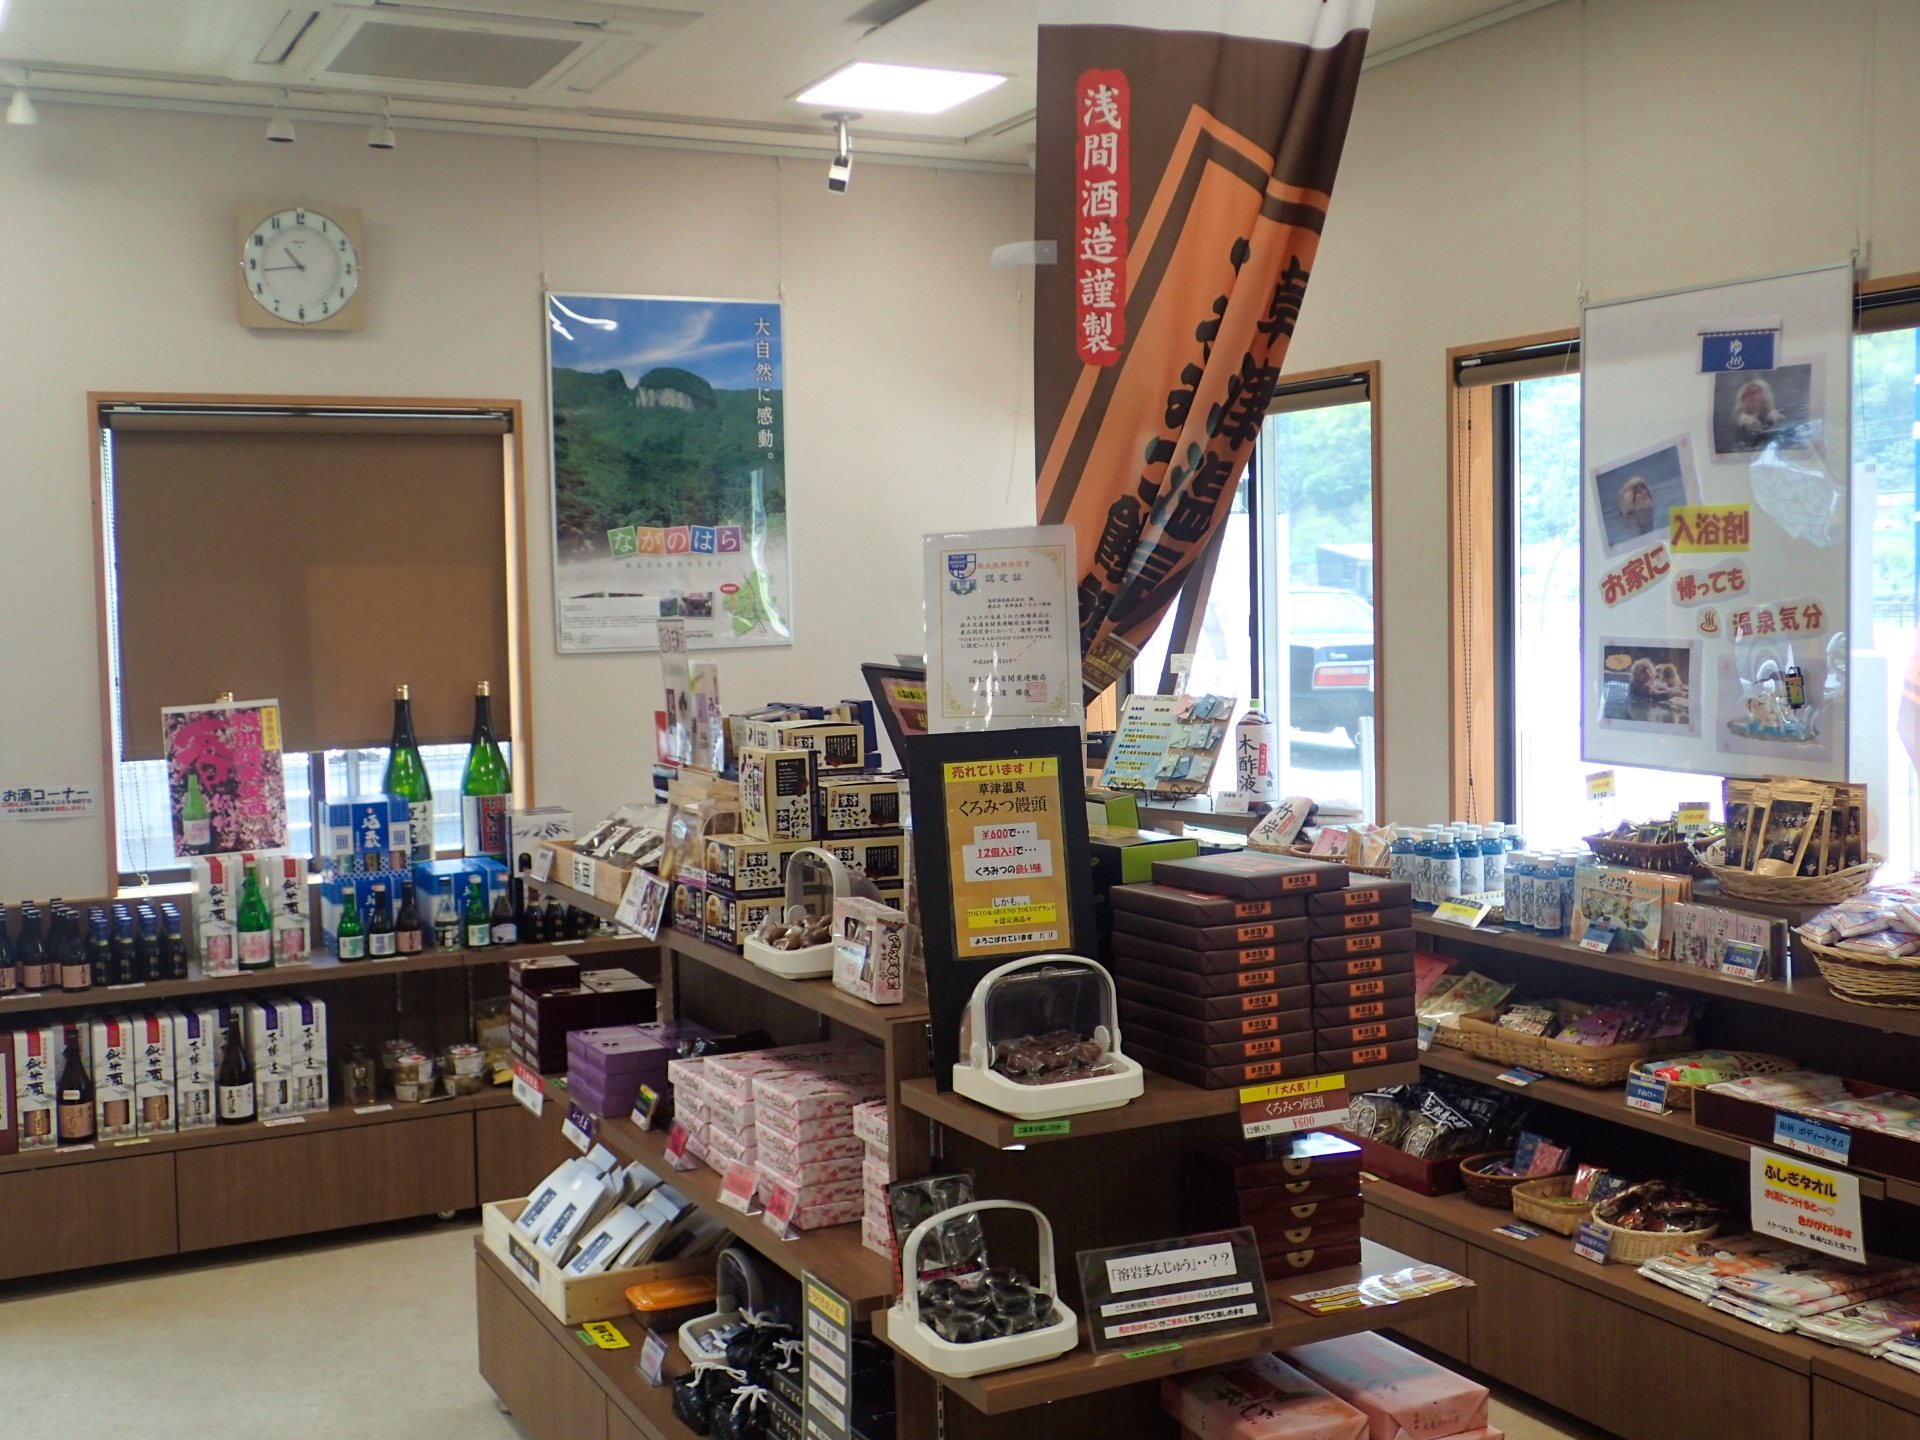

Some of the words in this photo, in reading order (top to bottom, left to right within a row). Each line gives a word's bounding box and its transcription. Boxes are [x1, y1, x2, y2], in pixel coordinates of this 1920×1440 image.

[1080, 84, 1121, 354] 浅間酒造謹製
[254, 234, 264, 247] 10
[754, 317, 774, 460] 大自然に感動。
[1670, 511, 1750, 547] 入浴剤
[612, 528, 738, 554] ながのはら
[984, 573, 1023, 583] 認定証
[1601, 546, 1671, 604] お家に
[1676, 568, 1746, 601] 帰っても
[1732, 603, 1824, 637] 温泉気分
[1238, 733, 1261, 794] 木酢液
[3, 787, 89, 801] お酒コーナー
[978, 781, 1026, 795] 草津温泉
[958, 796, 1047, 817] くろみつ饅頭
[975, 863, 1043, 877] くろみつの良い味
[1265, 1095, 1324, 1116] くろみつ饅頭
[1292, 1117, 1315, 1128] ¥600
[1799, 1127, 1845, 1147] ボディータオル
[1765, 1165, 1836, 1197] ふしぎタオル
